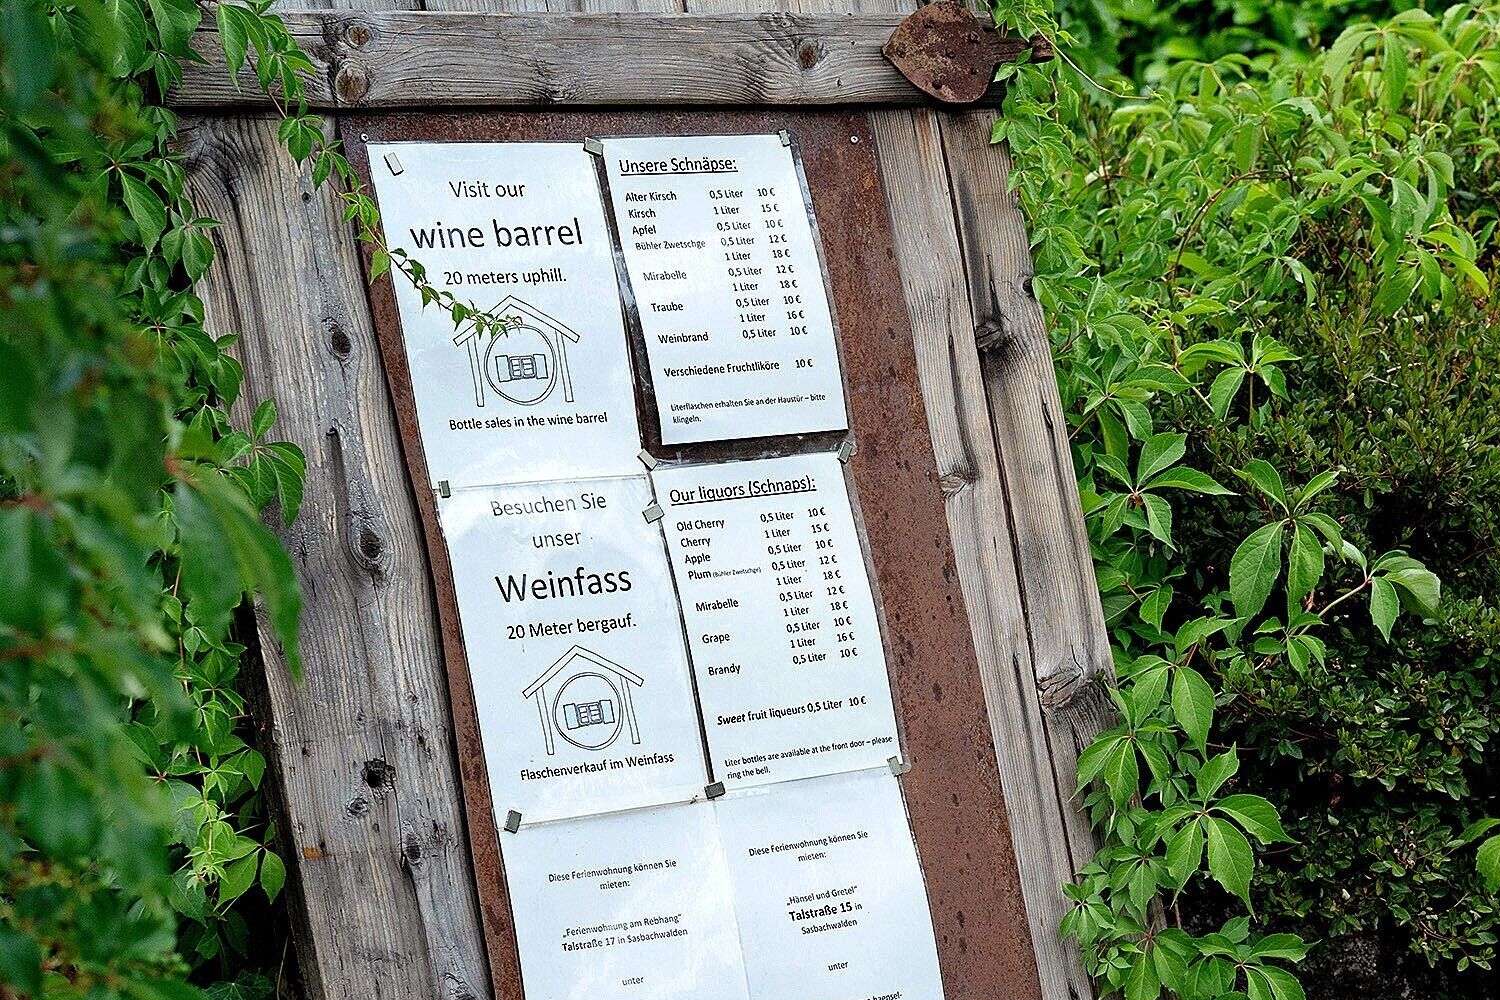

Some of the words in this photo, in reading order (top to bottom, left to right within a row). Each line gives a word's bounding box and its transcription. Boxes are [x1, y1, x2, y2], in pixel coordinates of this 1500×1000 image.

[619, 159, 667, 173] Unsere
[670, 157, 738, 172] Schnäpse:
[449, 181, 490, 198] Visit
[495, 184, 525, 197] our
[625, 192, 647, 202] Alter
[649, 191, 677, 201] Kirsch
[709, 190, 723, 200] 0,5
[724, 189, 743, 199] Liter
[757, 188, 768, 197] 10
[628, 208, 656, 218] Kirsch
[761, 204, 772, 213] 15
[409, 221, 485, 249] wine
[492, 217, 582, 247] barrel
[632, 224, 657, 237] Apfel
[716, 222, 731, 232] 0,5
[732, 221, 751, 230] Liter
[765, 219, 776, 228] 10
[635, 241, 662, 250] Bühler
[663, 240, 706, 249] Zwetschge
[720, 237, 735, 247] 0,5
[735, 237, 754, 245] Liter
[769, 234, 779, 243] 12
[772, 249, 783, 258] 18
[444, 271, 463, 285] 20
[467, 271, 519, 284] meters
[522, 268, 567, 286] uphill.
[643, 270, 687, 281] Mirabelle
[728, 268, 742, 277] 0,5
[743, 267, 762, 276] Liter
[776, 265, 787, 274] 12
[780, 280, 791, 289] 18
[650, 302, 684, 312] Traube
[735, 298, 750, 308] 0,5
[750, 298, 769, 307] Liter
[783, 295, 794, 304] 10
[787, 310, 797, 320] 16
[657, 331, 709, 344] Weinbrand
[742, 329, 756, 340] 0,5
[757, 328, 776, 338] Liter
[790, 326, 800, 335] 10
[663, 365, 725, 377] Verschiedene
[727, 361, 780, 373] Fruchtliköre
[795, 359, 806, 368] 10
[670, 402, 714, 412] Literflaschen
[714, 400, 743, 409] erhalten
[743, 398, 754, 406] Sie
[765, 397, 776, 405] der
[777, 395, 803, 404] Haustür
[449, 418, 482, 430] Bottle
[485, 417, 512, 429] sales
[514, 416, 525, 427] in
[527, 415, 545, 426] the
[547, 414, 573, 425] wine
[575, 412, 608, 424] barrel
[672, 415, 702, 425] klingeln.
[670, 489, 695, 502] Our
[699, 485, 745, 501] liquors
[748, 475, 817, 495] (Schnaps):
[490, 496, 576, 517] Besuchen
[581, 493, 607, 510] Sie
[676, 521, 693, 532] Old
[694, 520, 724, 530] Cherry
[760, 513, 774, 523] 0,5
[775, 512, 794, 521] Liter
[808, 508, 818, 517] 10
[532, 532, 581, 549] unser
[680, 537, 710, 548] Cherry
[811, 524, 822, 533] 15
[685, 553, 711, 565] Apple
[767, 545, 782, 555] 0,5
[782, 544, 801, 553] Liter
[815, 539, 826, 549] 10
[688, 570, 712, 580] Plum
[771, 561, 786, 571] 0,5
[786, 560, 805, 569] Liter
[819, 555, 830, 565] 12
[823, 570, 834, 580] 18
[494, 567, 632, 603] Weinfass
[696, 598, 739, 612] Mirabelle
[779, 592, 793, 602] 0,5
[794, 591, 813, 600] Liter
[827, 586, 837, 596] 12
[830, 601, 841, 611] 18
[506, 625, 525, 639] 20
[529, 622, 573, 637] Meter
[577, 613, 636, 633] bergauf.
[702, 633, 730, 644] Grape
[786, 623, 800, 634] 0,5
[801, 621, 820, 631] Liter
[834, 617, 845, 627] 10
[837, 632, 848, 642] 16
[708, 663, 740, 676] Brandy
[792, 654, 806, 665] 0,5
[807, 653, 826, 662] Liter
[840, 648, 851, 658] 10
[717, 714, 746, 726] Sweet
[748, 710, 768, 721] fruit
[769, 706, 806, 719] liqueurs
[807, 701, 821, 713] 0,5
[822, 700, 842, 710] Liter
[849, 697, 859, 707] 10
[724, 759, 741, 767] Liter
[741, 755, 767, 764] bottles
[767, 753, 779, 761] are
[780, 748, 810, 759] available
[819, 745, 831, 753] the
[832, 742, 849, 750] front
[849, 740, 865, 748] door
[871, 736, 892, 746] please
[520, 759, 607, 781] Flaschenverkauf
[609, 759, 624, 769] im
[625, 753, 674, 767] Weinfass
[727, 771, 742, 780] ring
[742, 769, 754, 777] the
[755, 766, 771, 775] bell.
[749, 847, 769, 856] Diese
[770, 838, 828, 853] Ferienwohnung
[828, 833, 856, 843] können
[856, 831, 868, 839] Sie
[798, 852, 827, 862] mieten:
[548, 873, 570, 883] Diese
[571, 866, 633, 879] Ferienwohnung
[633, 862, 663, 872] können
[664, 859, 677, 868] Sie
[600, 880, 630, 890] mieten:
[815, 890, 831, 900] und
[788, 904, 837, 921] Talstraße
[839, 901, 853, 913] 15
[801, 919, 858, 935] Sasbachwalden
[561, 939, 603, 951] Talstraße
[605, 937, 615, 946] 17
[617, 936, 626, 944] in
[627, 928, 688, 943] Sasbachwalden
[828, 962, 848, 971] unter
[622, 977, 644, 986] unter
